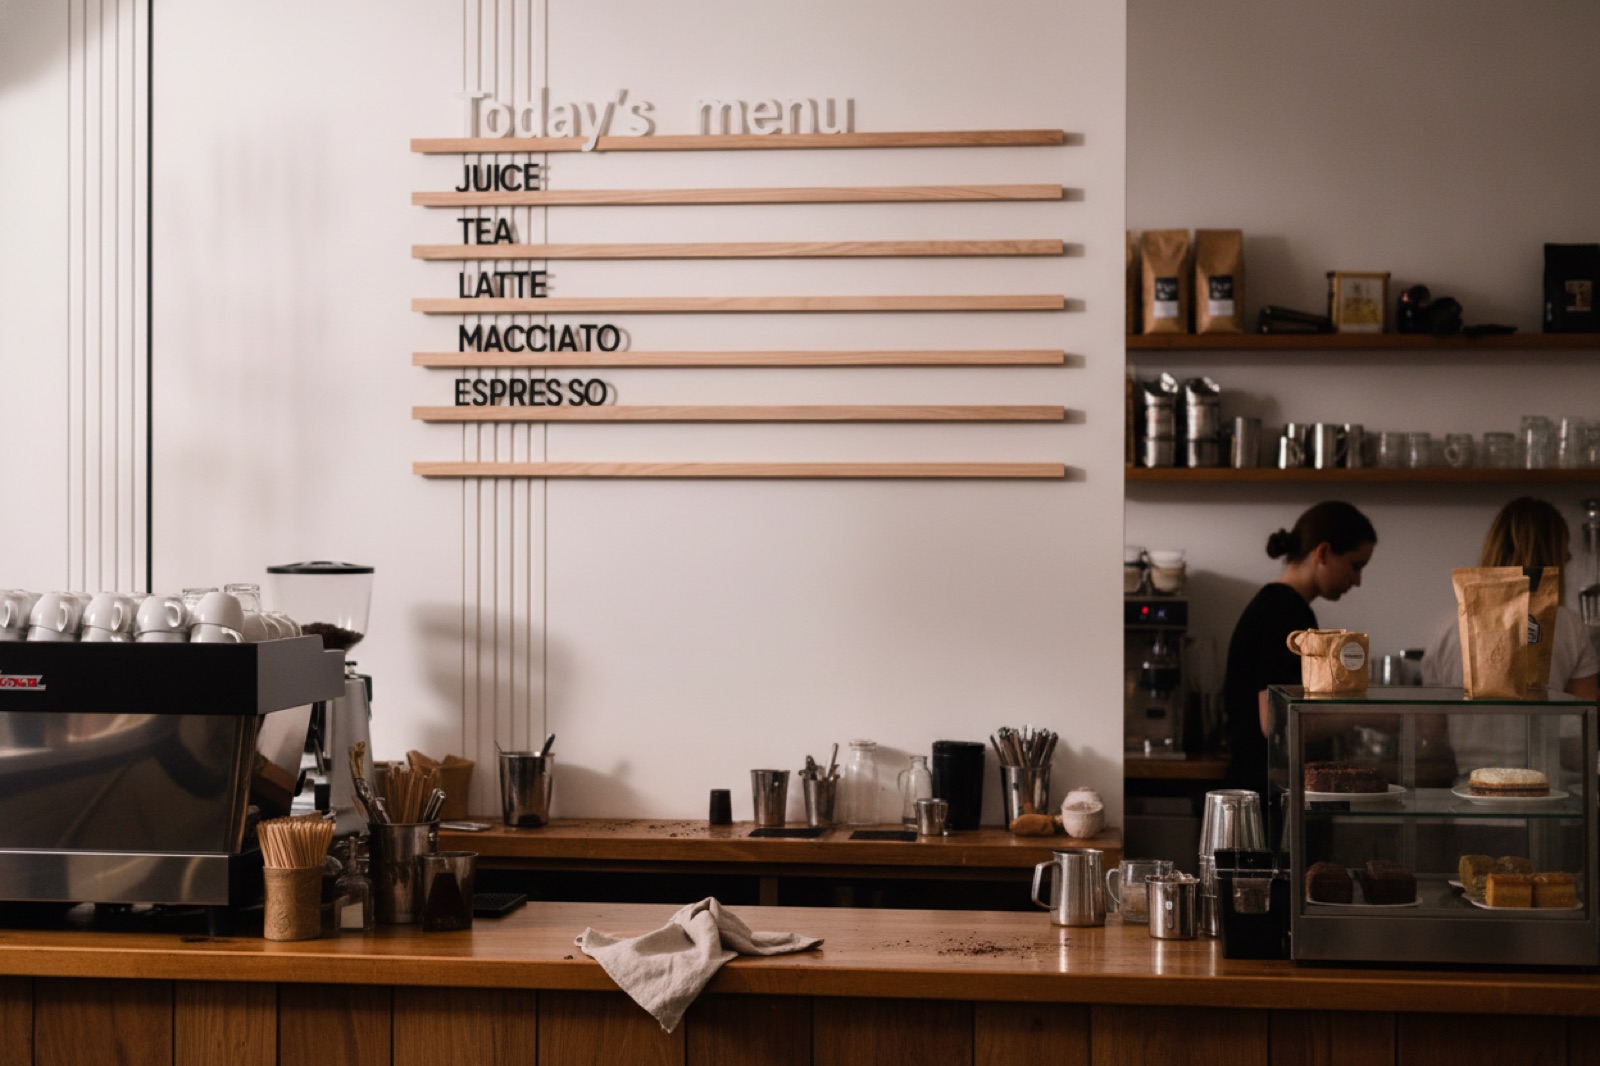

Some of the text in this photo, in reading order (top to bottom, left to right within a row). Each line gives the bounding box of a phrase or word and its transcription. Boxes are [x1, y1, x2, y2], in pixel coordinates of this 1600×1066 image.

[456, 87, 854, 152] Today's menu
[456, 163, 540, 193] JUICE
[458, 217, 514, 246] TEA
[460, 271, 547, 299] LATTE
[459, 324, 620, 354] MACCIATO
